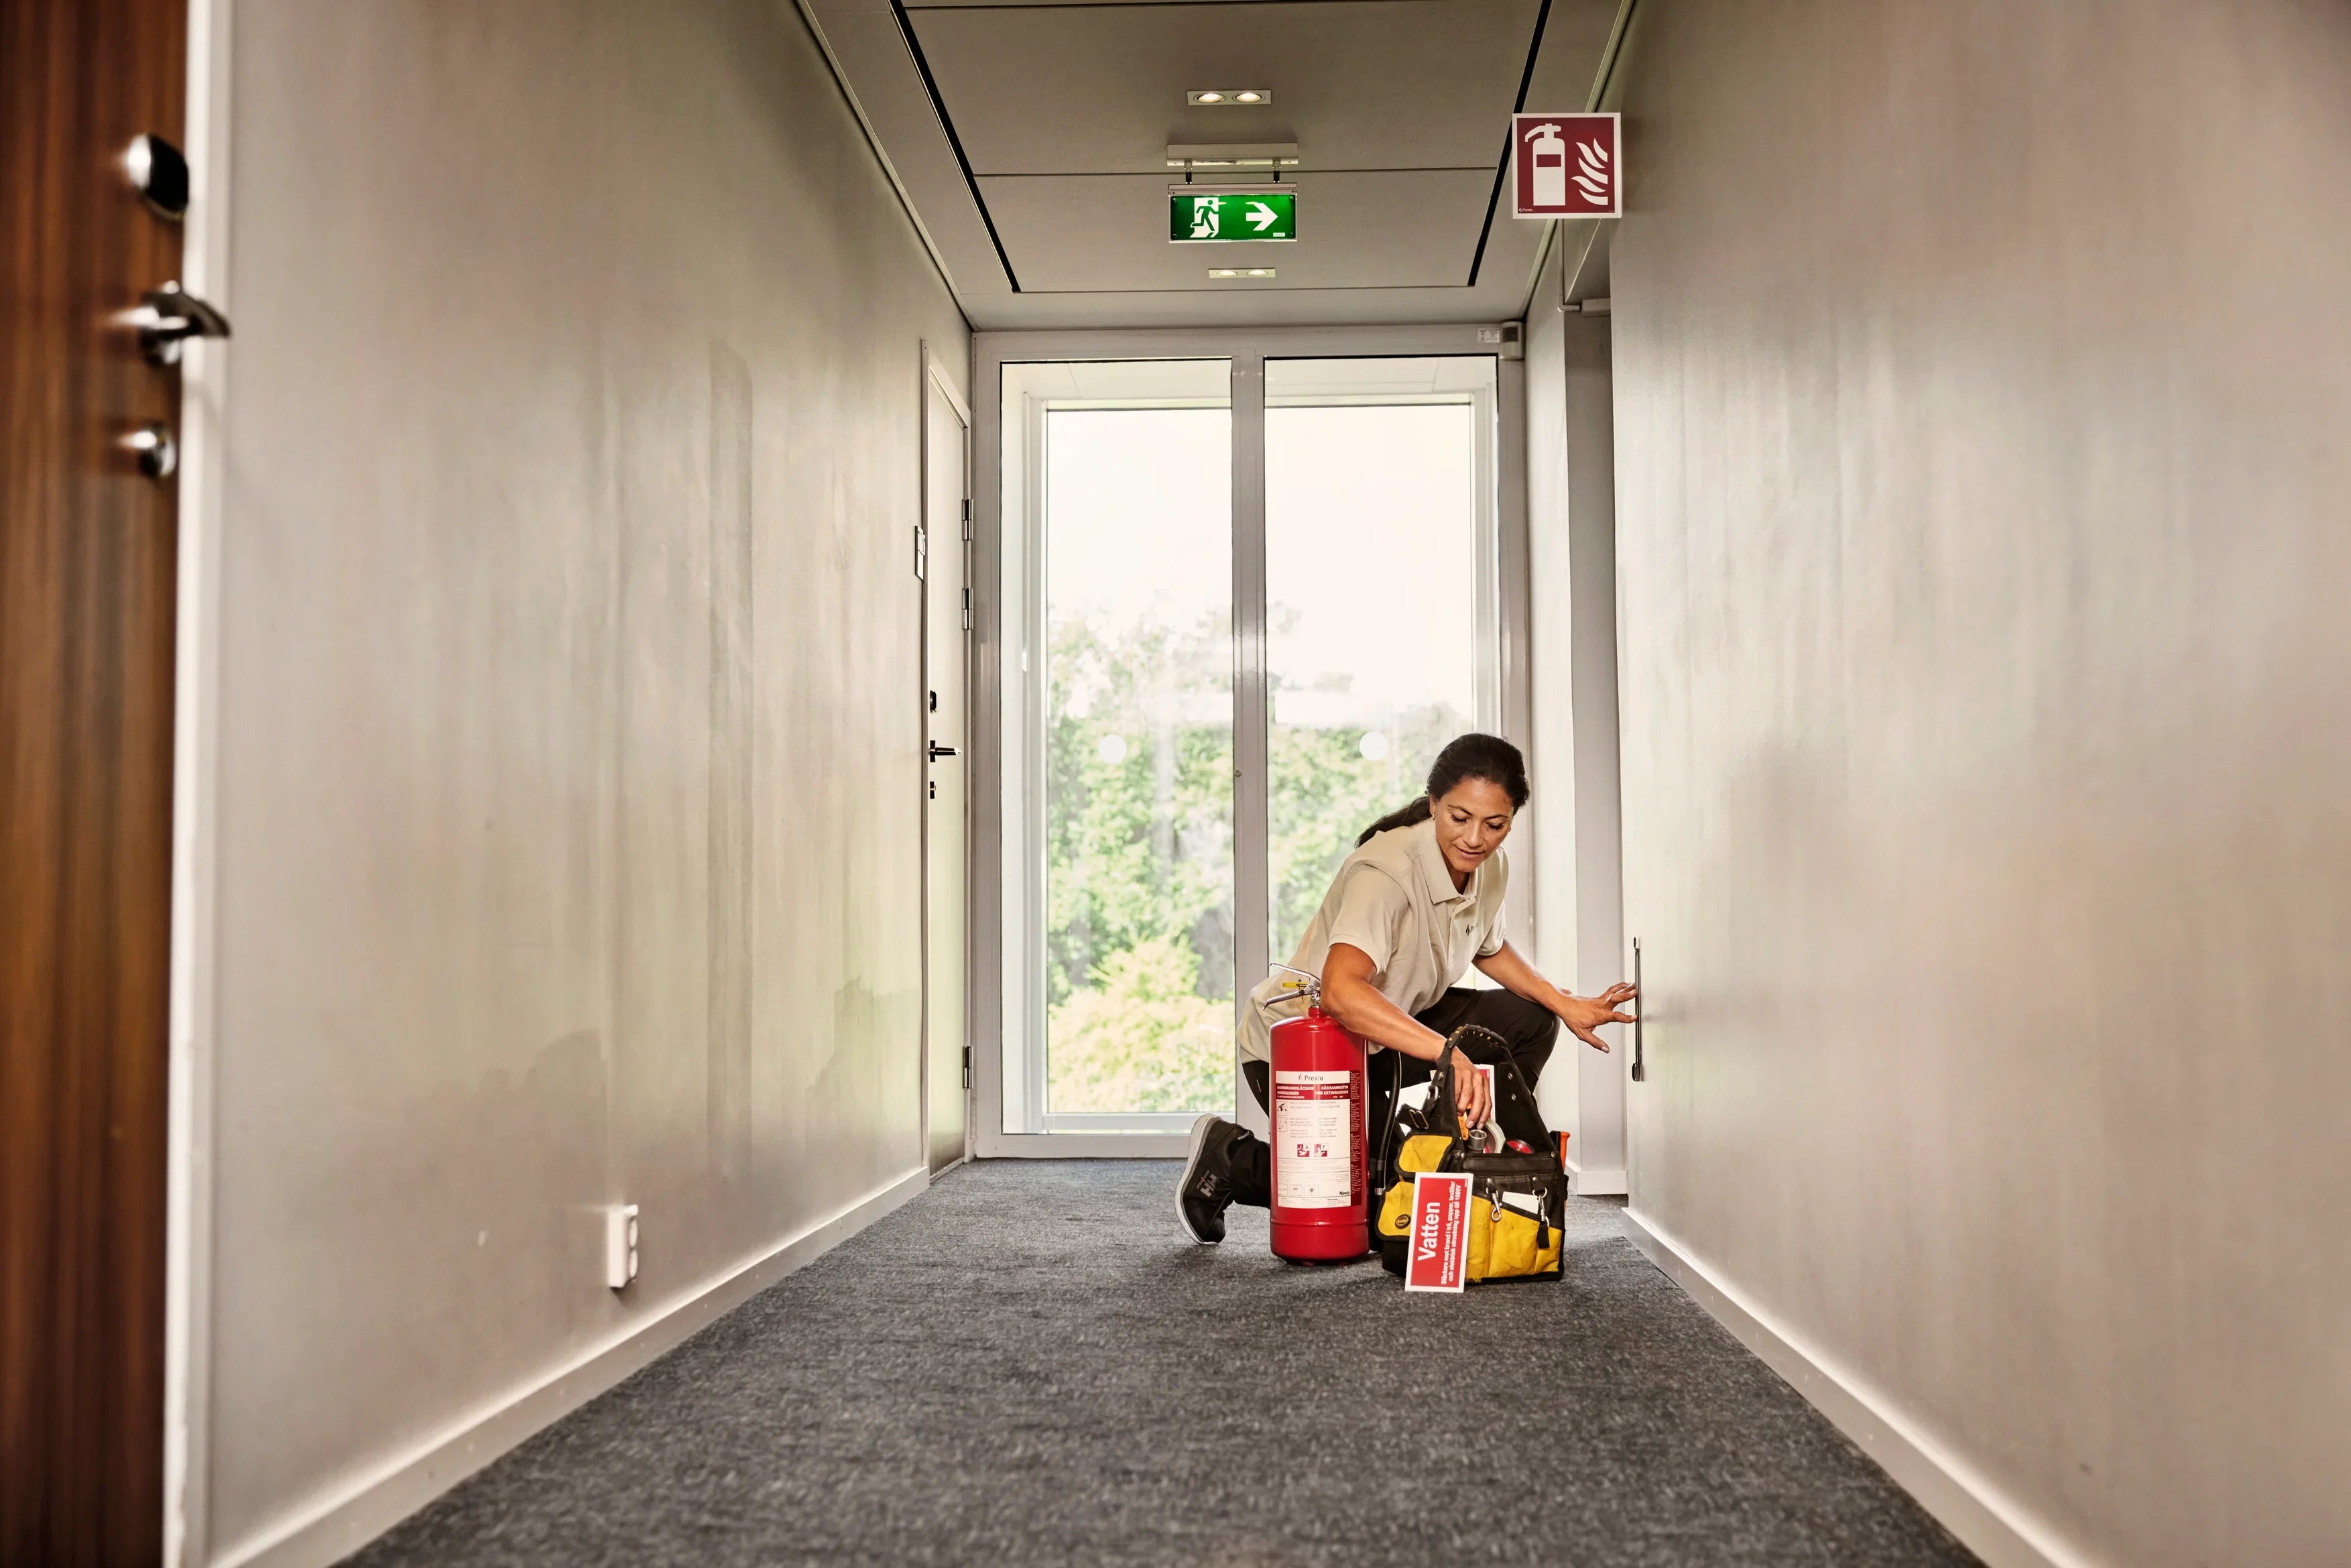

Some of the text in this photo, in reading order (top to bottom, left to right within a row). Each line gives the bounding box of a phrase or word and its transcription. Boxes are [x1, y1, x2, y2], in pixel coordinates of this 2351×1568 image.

[1417, 1202, 1441, 1261] Vatten
[1451, 1220, 1459, 1248] utrustning
[1441, 1262, 1449, 1285] Släckare
